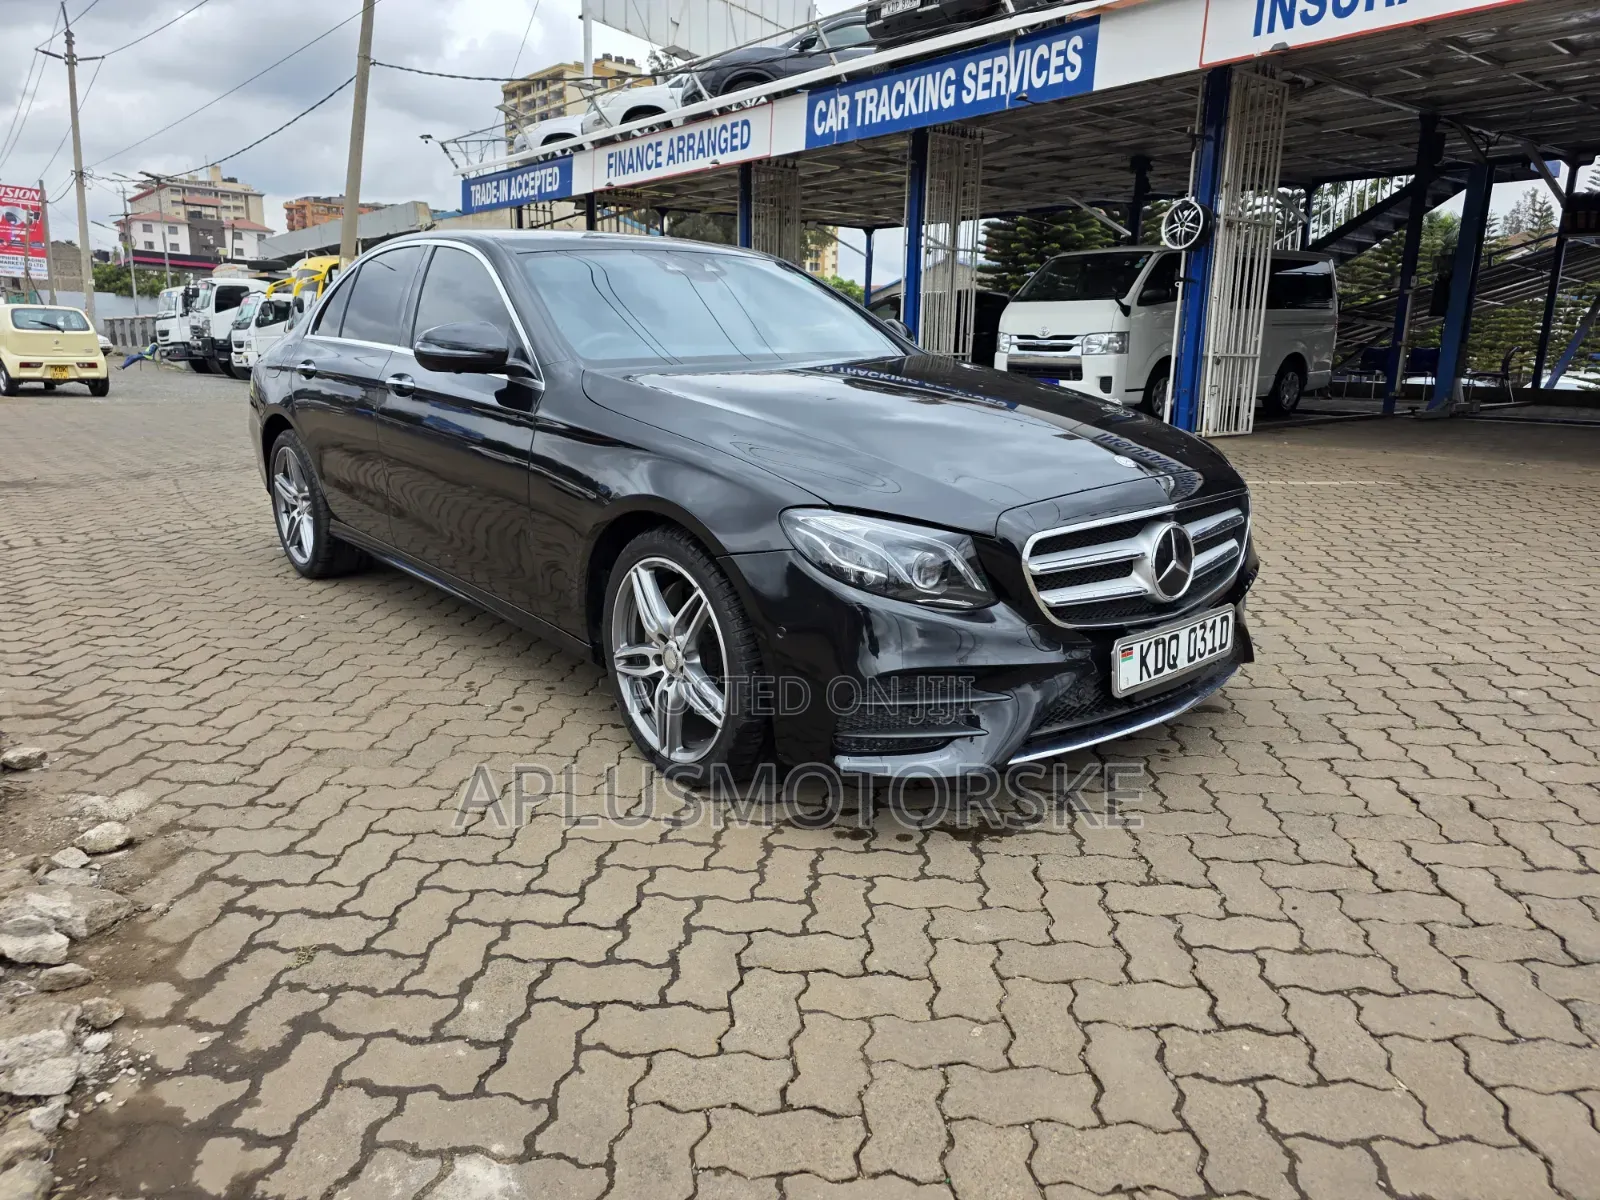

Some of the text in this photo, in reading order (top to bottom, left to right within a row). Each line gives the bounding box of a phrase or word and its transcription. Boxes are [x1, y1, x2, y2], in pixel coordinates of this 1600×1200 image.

[1253, 0, 1409, 38] INS
[813, 35, 1084, 136] CAR TRACKING SERVICES
[607, 118, 751, 179] FINANCE ARRANGED
[470, 166, 560, 207] TRADE-IN ACCEPTED
[1139, 614, 1230, 682] KDQ 031D
